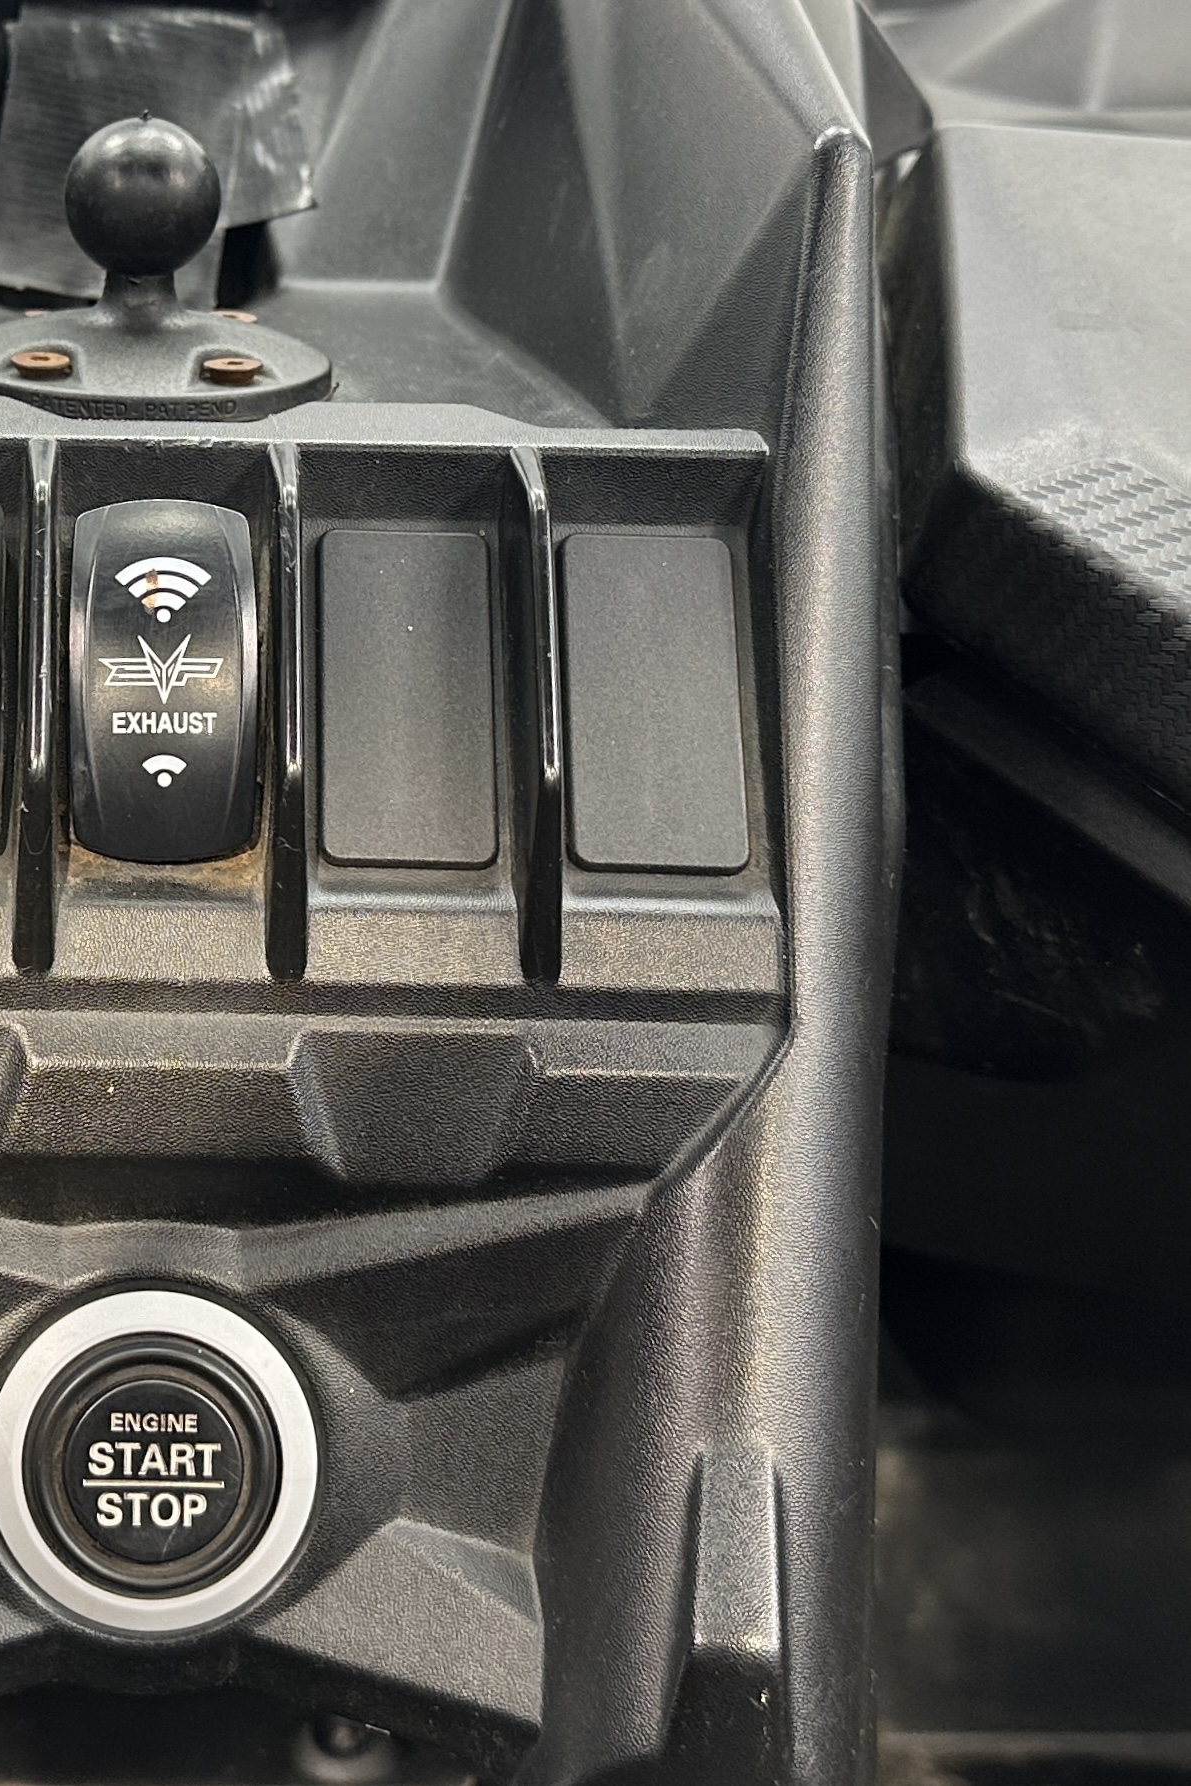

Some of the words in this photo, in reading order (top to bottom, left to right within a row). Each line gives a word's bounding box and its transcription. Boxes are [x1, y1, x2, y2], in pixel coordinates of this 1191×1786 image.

[112, 711, 218, 735] EXHAUST
[110, 1412, 199, 1433] ENGINE
[87, 1441, 222, 1477] START
[96, 1492, 208, 1528] STOP
